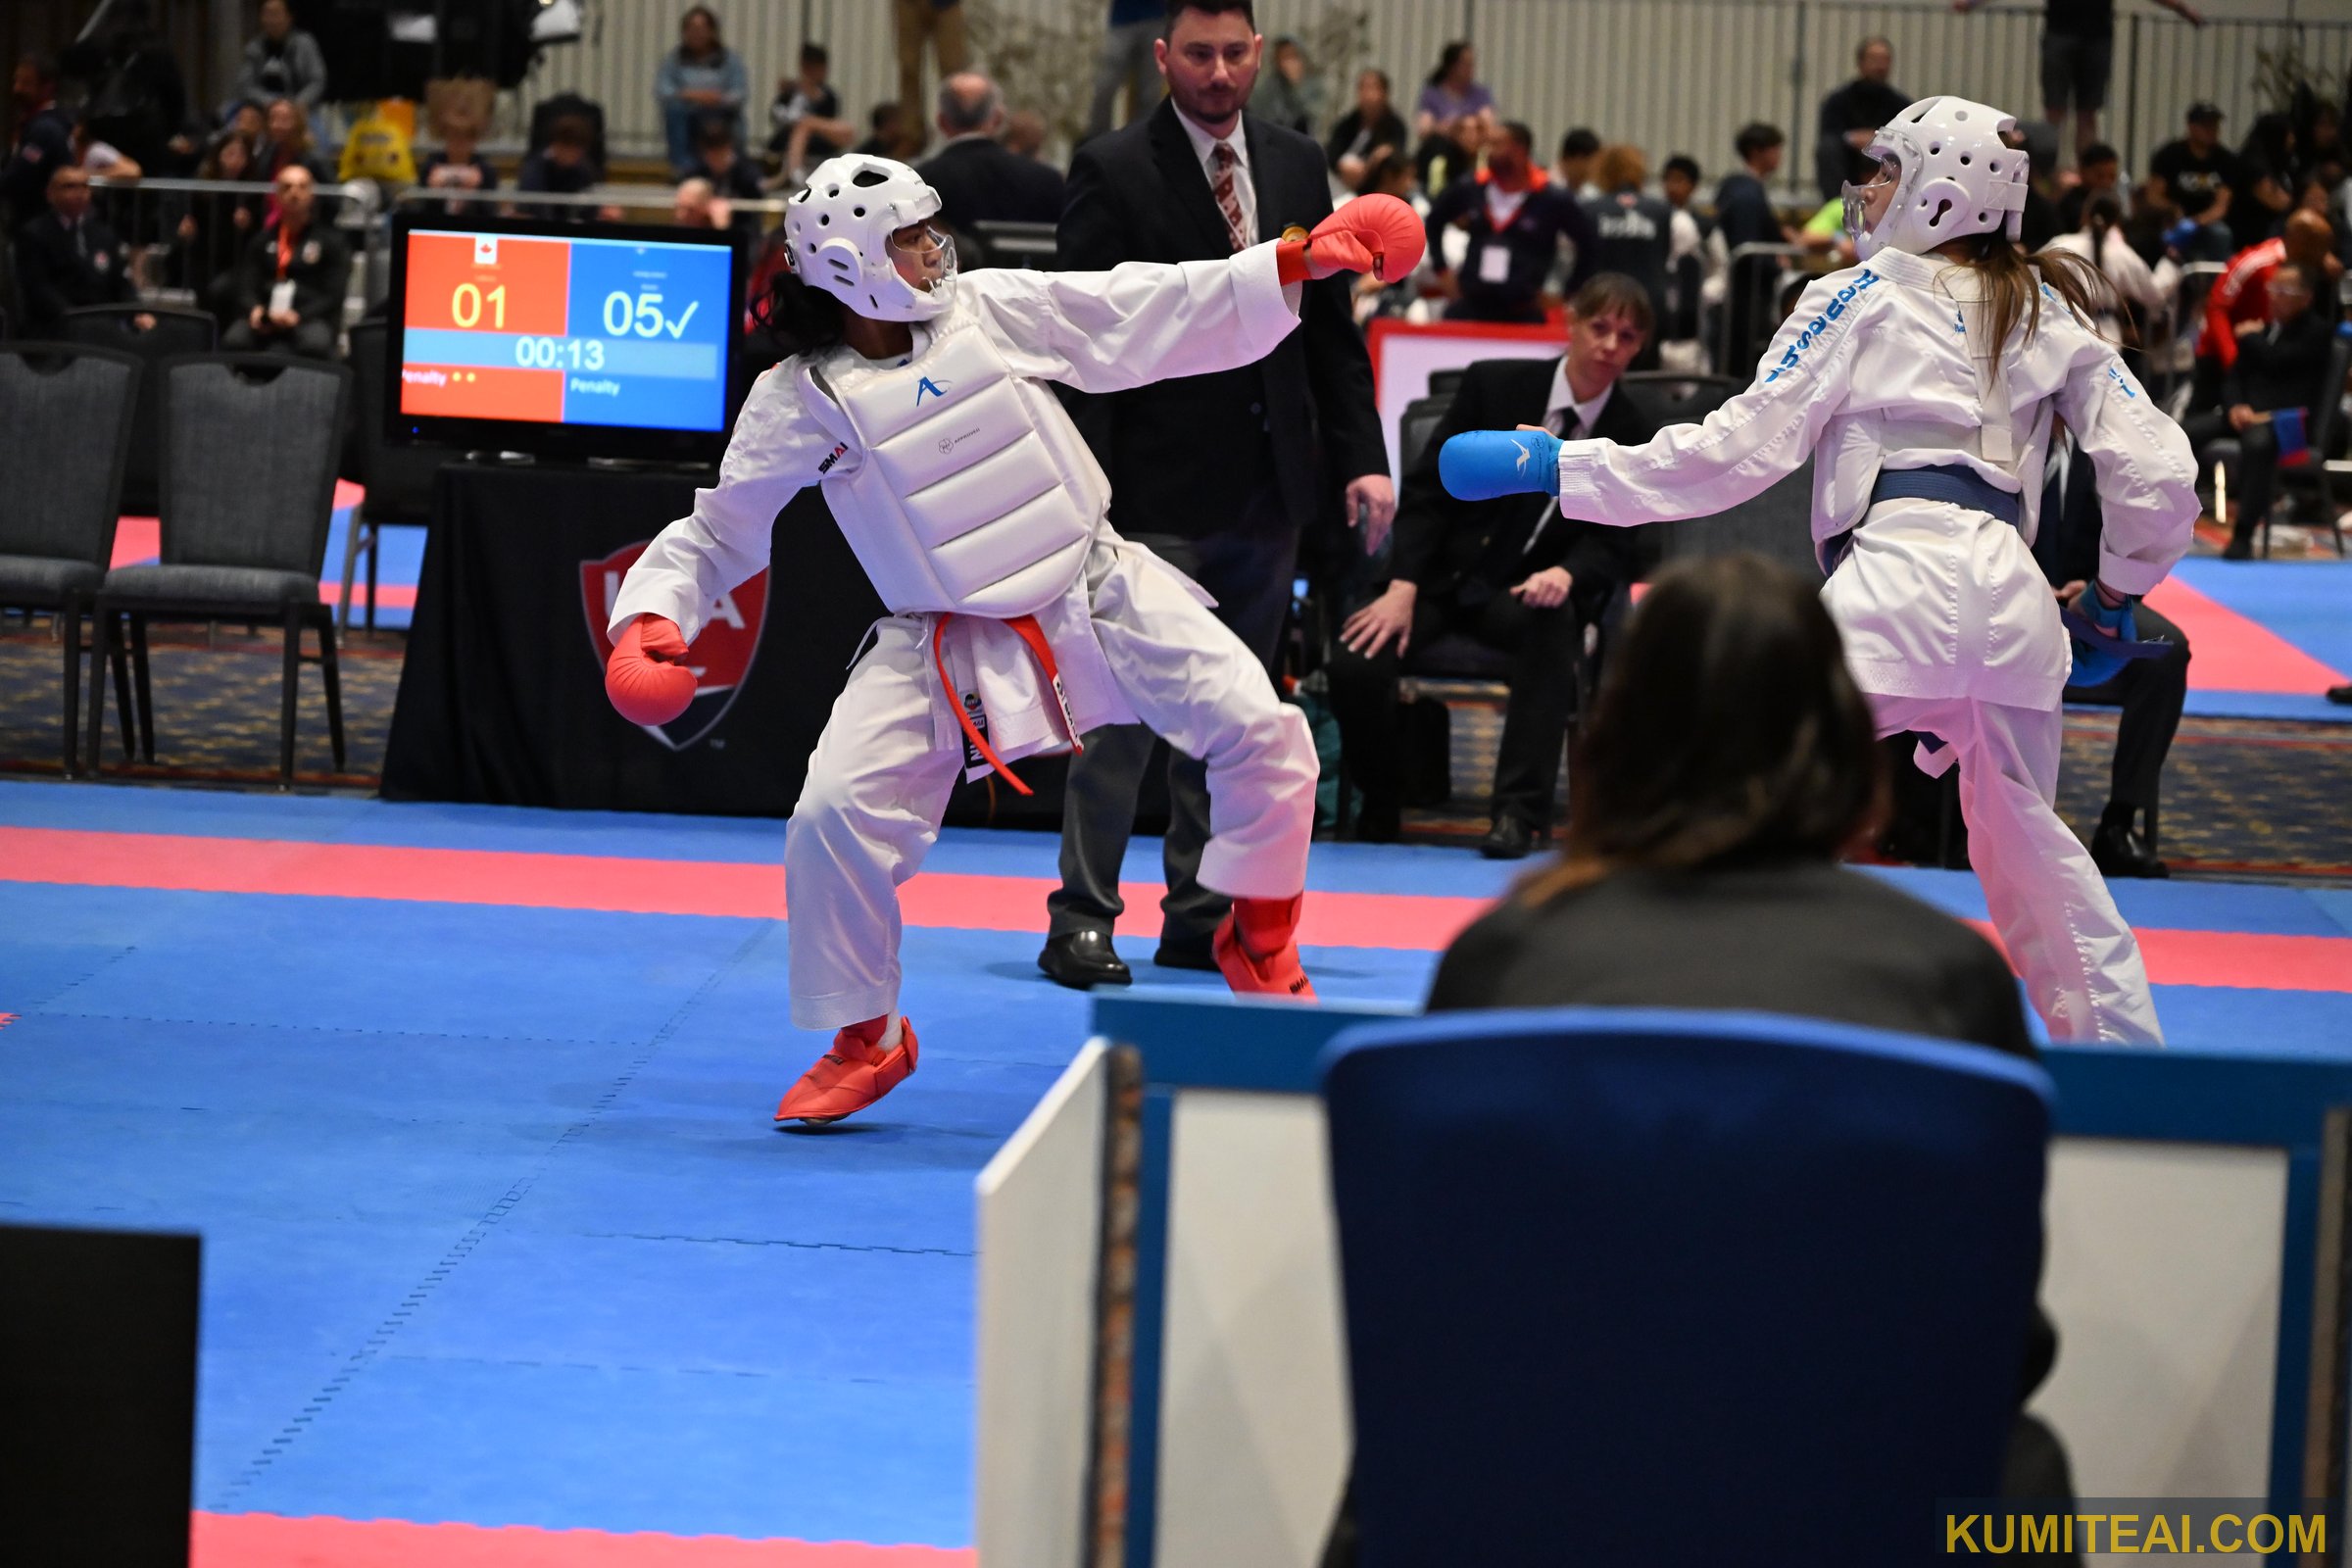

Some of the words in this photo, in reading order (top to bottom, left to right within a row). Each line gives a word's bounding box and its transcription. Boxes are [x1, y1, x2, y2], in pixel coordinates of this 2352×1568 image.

[452, 282, 506, 329] 01
[603, 291, 663, 337] 05
[515, 336, 606, 371] 00:13
[570, 377, 620, 397] Penalty
[818, 441, 849, 474] SMAI
